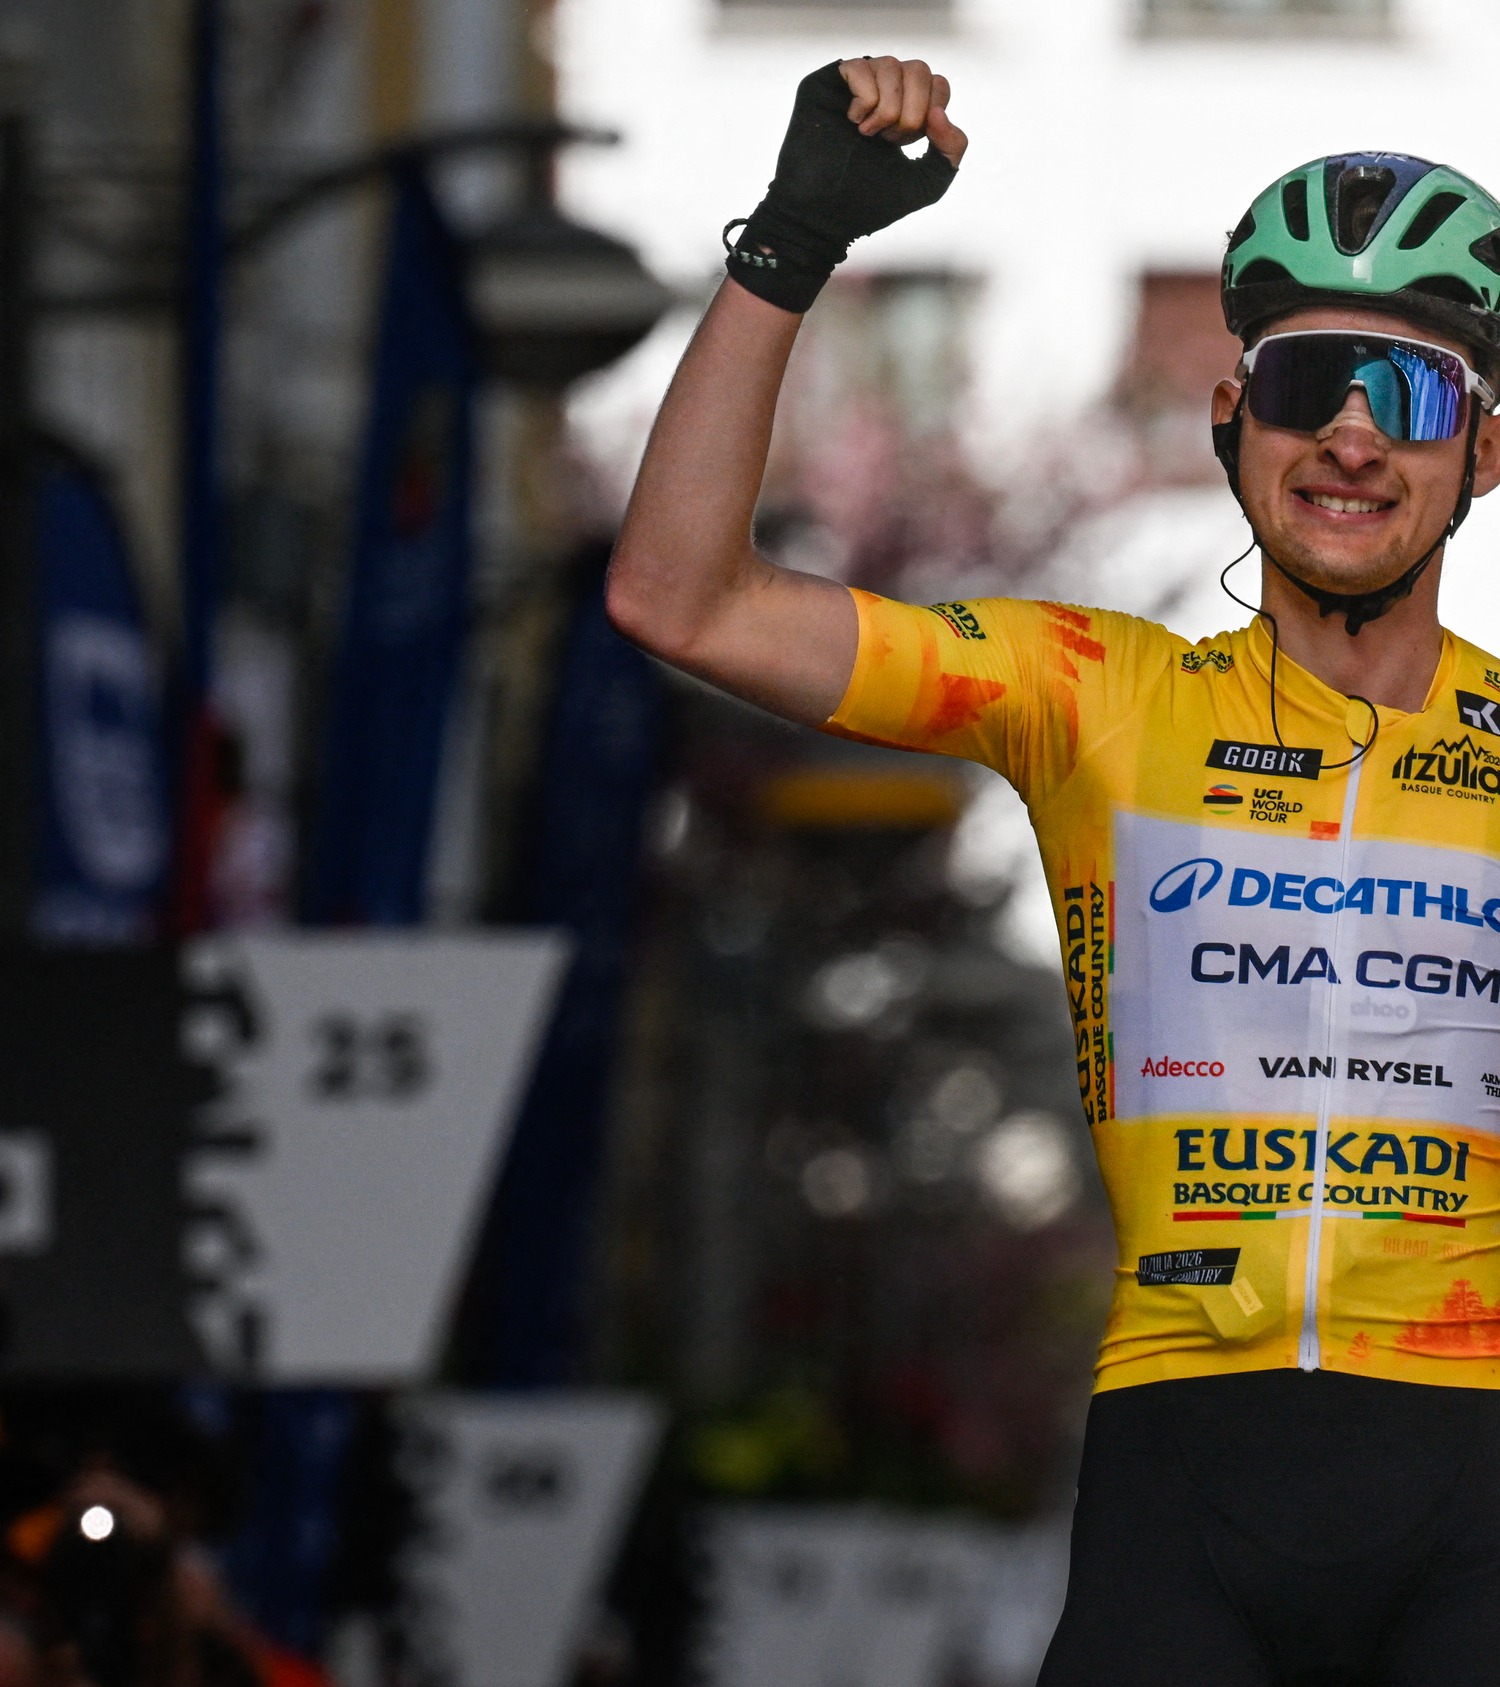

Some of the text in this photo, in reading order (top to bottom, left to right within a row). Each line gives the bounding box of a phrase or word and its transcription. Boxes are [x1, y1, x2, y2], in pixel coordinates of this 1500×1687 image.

[1223, 746, 1305, 773] GOBIK
[1251, 799, 1303, 814] WORLD
[1253, 788, 1284, 801] UCI
[1401, 783, 1496, 805] BASQUE COUNTRY
[1249, 810, 1288, 824] TOUR
[1190, 942, 1341, 985] CMA
[1089, 881, 1107, 1125] BASQUE COUNTRY
[1141, 1056, 1225, 1078] Adecco
[1258, 1056, 1453, 1088] VAN RYSEL
[1173, 1128, 1470, 1182] EUSKADI
[1173, 1182, 1469, 1213] BASQUE COUNTRY
